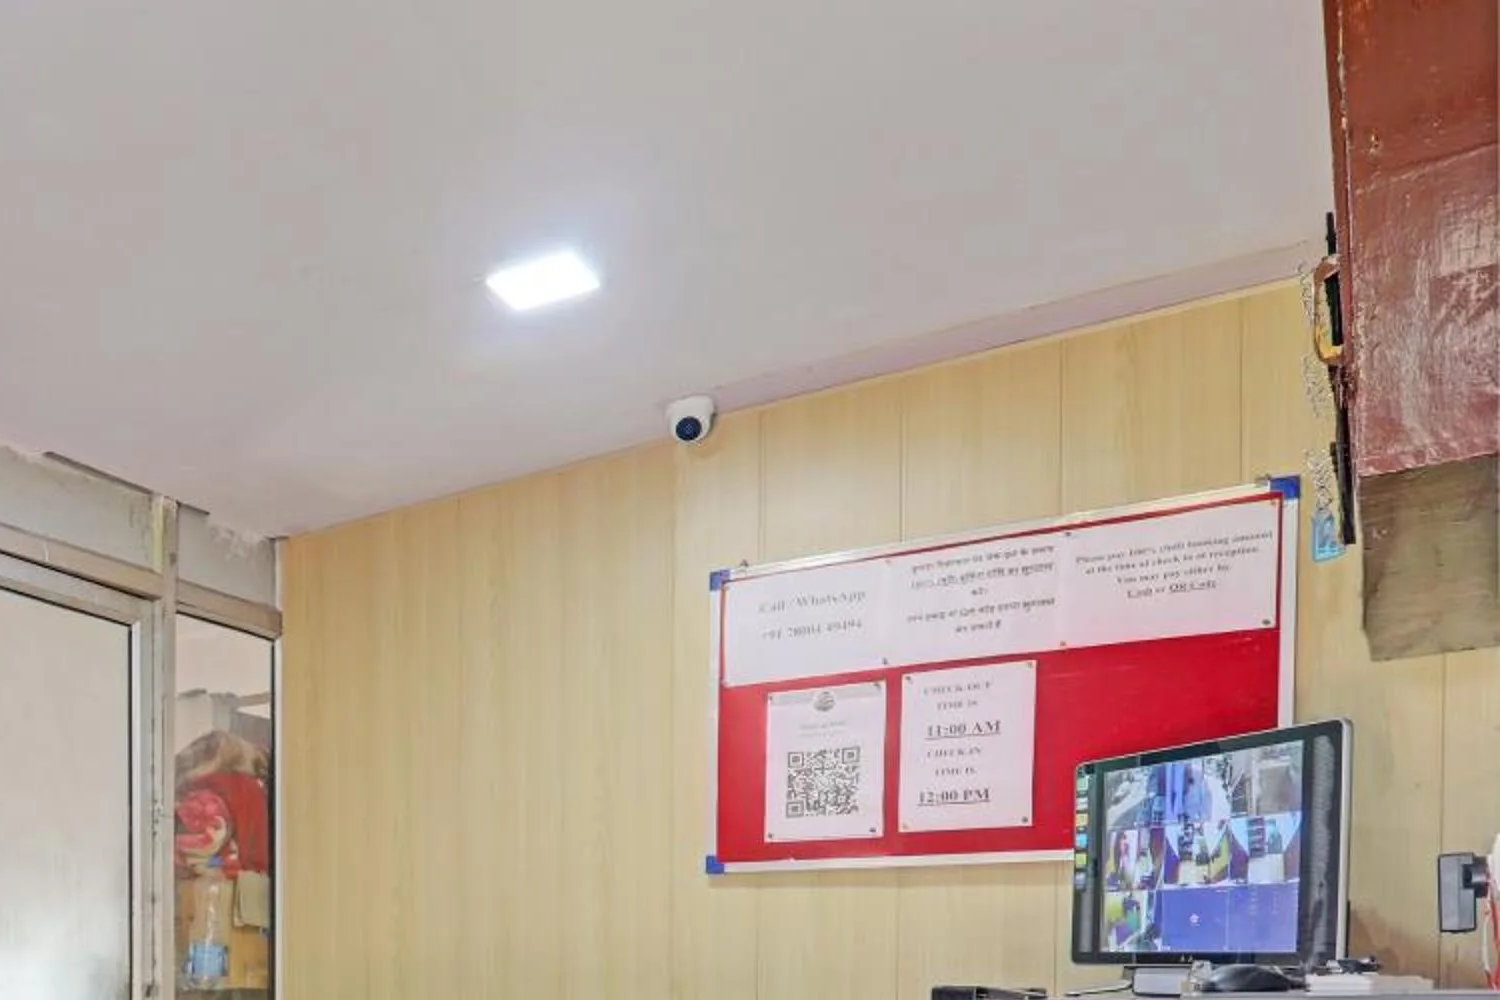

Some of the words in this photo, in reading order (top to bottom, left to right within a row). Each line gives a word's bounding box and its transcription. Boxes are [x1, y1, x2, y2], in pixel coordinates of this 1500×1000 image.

[927, 723, 967, 738] 11:00
[972, 719, 1002, 735] AM
[919, 790, 960, 804] 12:00
[963, 787, 990, 801] PM
